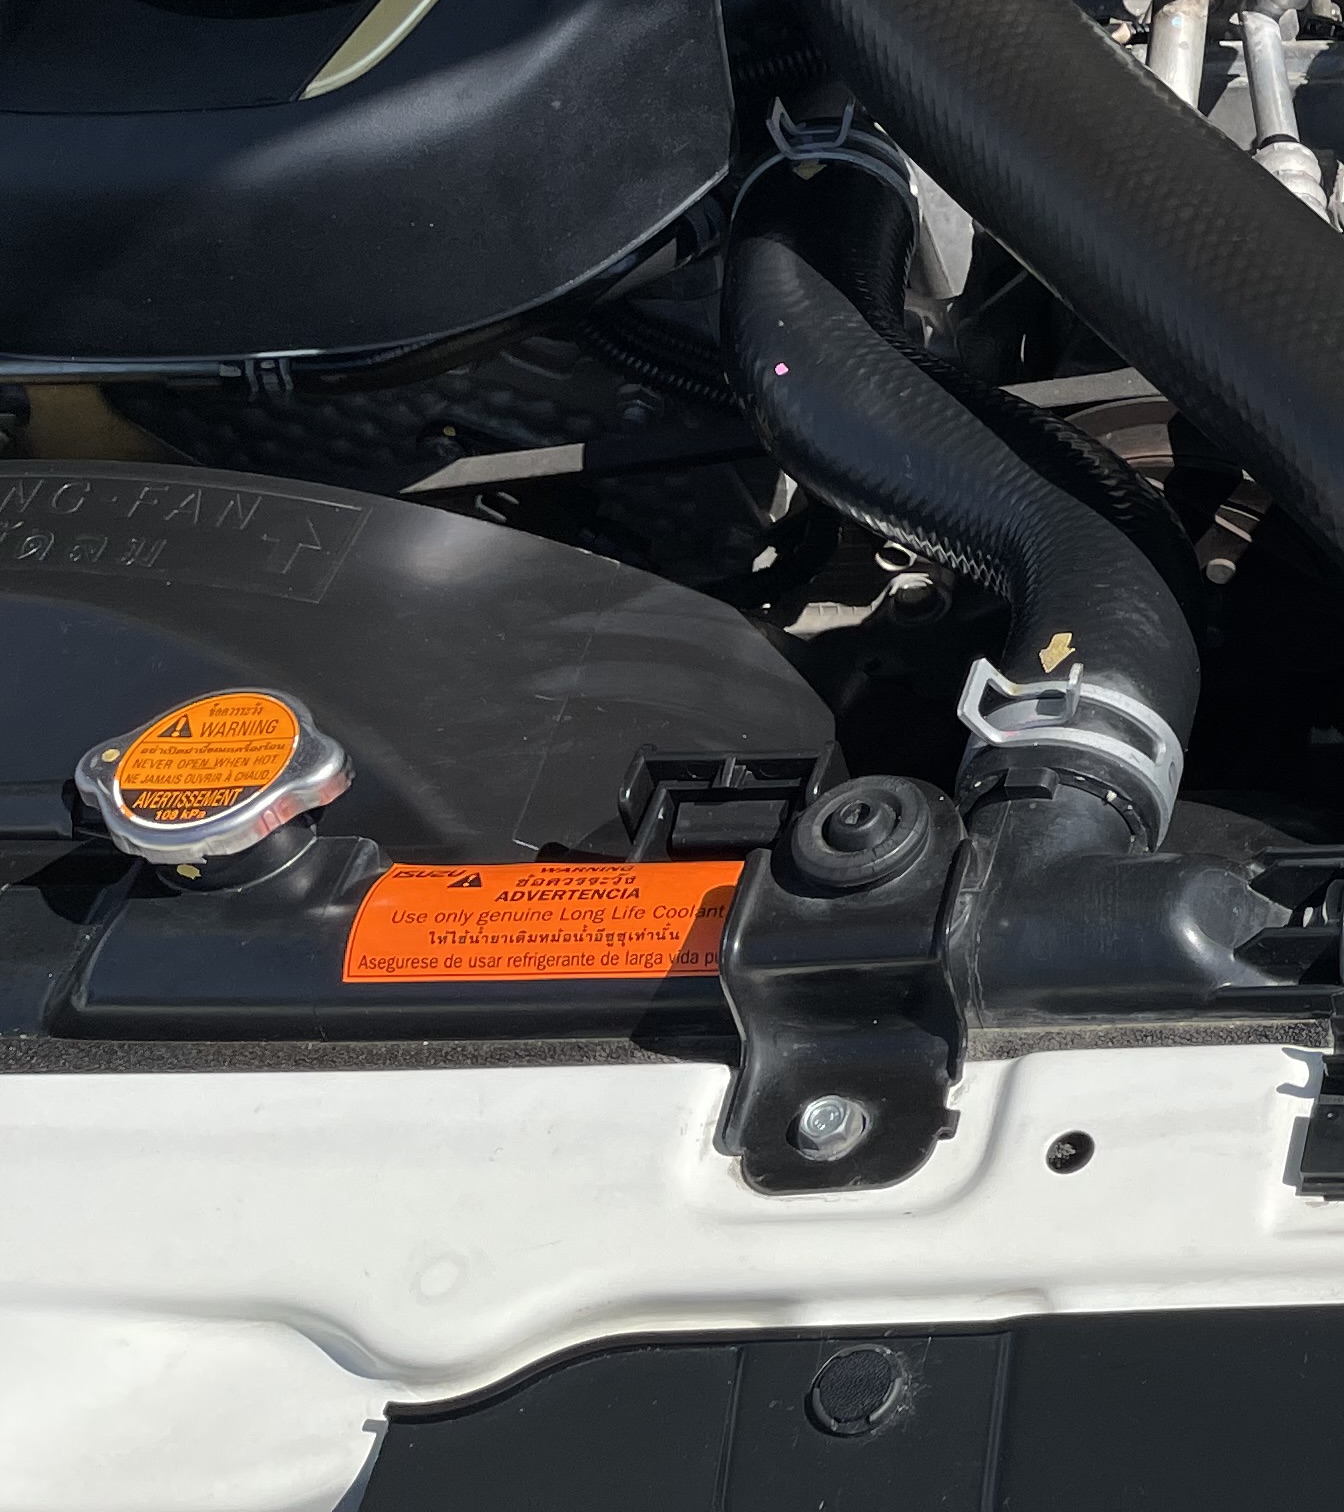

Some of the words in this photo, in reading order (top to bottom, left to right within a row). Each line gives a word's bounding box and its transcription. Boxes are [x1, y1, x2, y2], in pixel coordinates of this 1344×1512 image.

[200, 719, 279, 738] WARNING
[132, 758, 173, 770] NEVER
[178, 758, 212, 769] OPEN
[214, 757, 249, 768] WHEN
[124, 773, 137, 784] NE
[140, 773, 184, 785] JAMAIS
[185, 772, 223, 784] OUVRIR
[223, 768, 232, 782] À
[132, 788, 243, 809] AVERTISSEMENT
[180, 809, 206, 820] kPa
[393, 869, 468, 879] ISUZU
[541, 865, 635, 873] WARNING
[494, 888, 640, 903] ADVERTENCIA
[391, 909, 428, 924] Use
[434, 909, 474, 926] only
[476, 907, 553, 926] genuine
[560, 906, 606, 924] Long
[611, 905, 646, 920] Life
[652, 904, 725, 920] Coolant
[358, 954, 439, 973] Asegurese
[443, 953, 462, 968] de
[468, 955, 503, 968] usar
[507, 950, 595, 971] refrigerante
[600, 951, 620, 966] de
[625, 950, 663, 968] larga
[669, 948, 699, 964] vida
